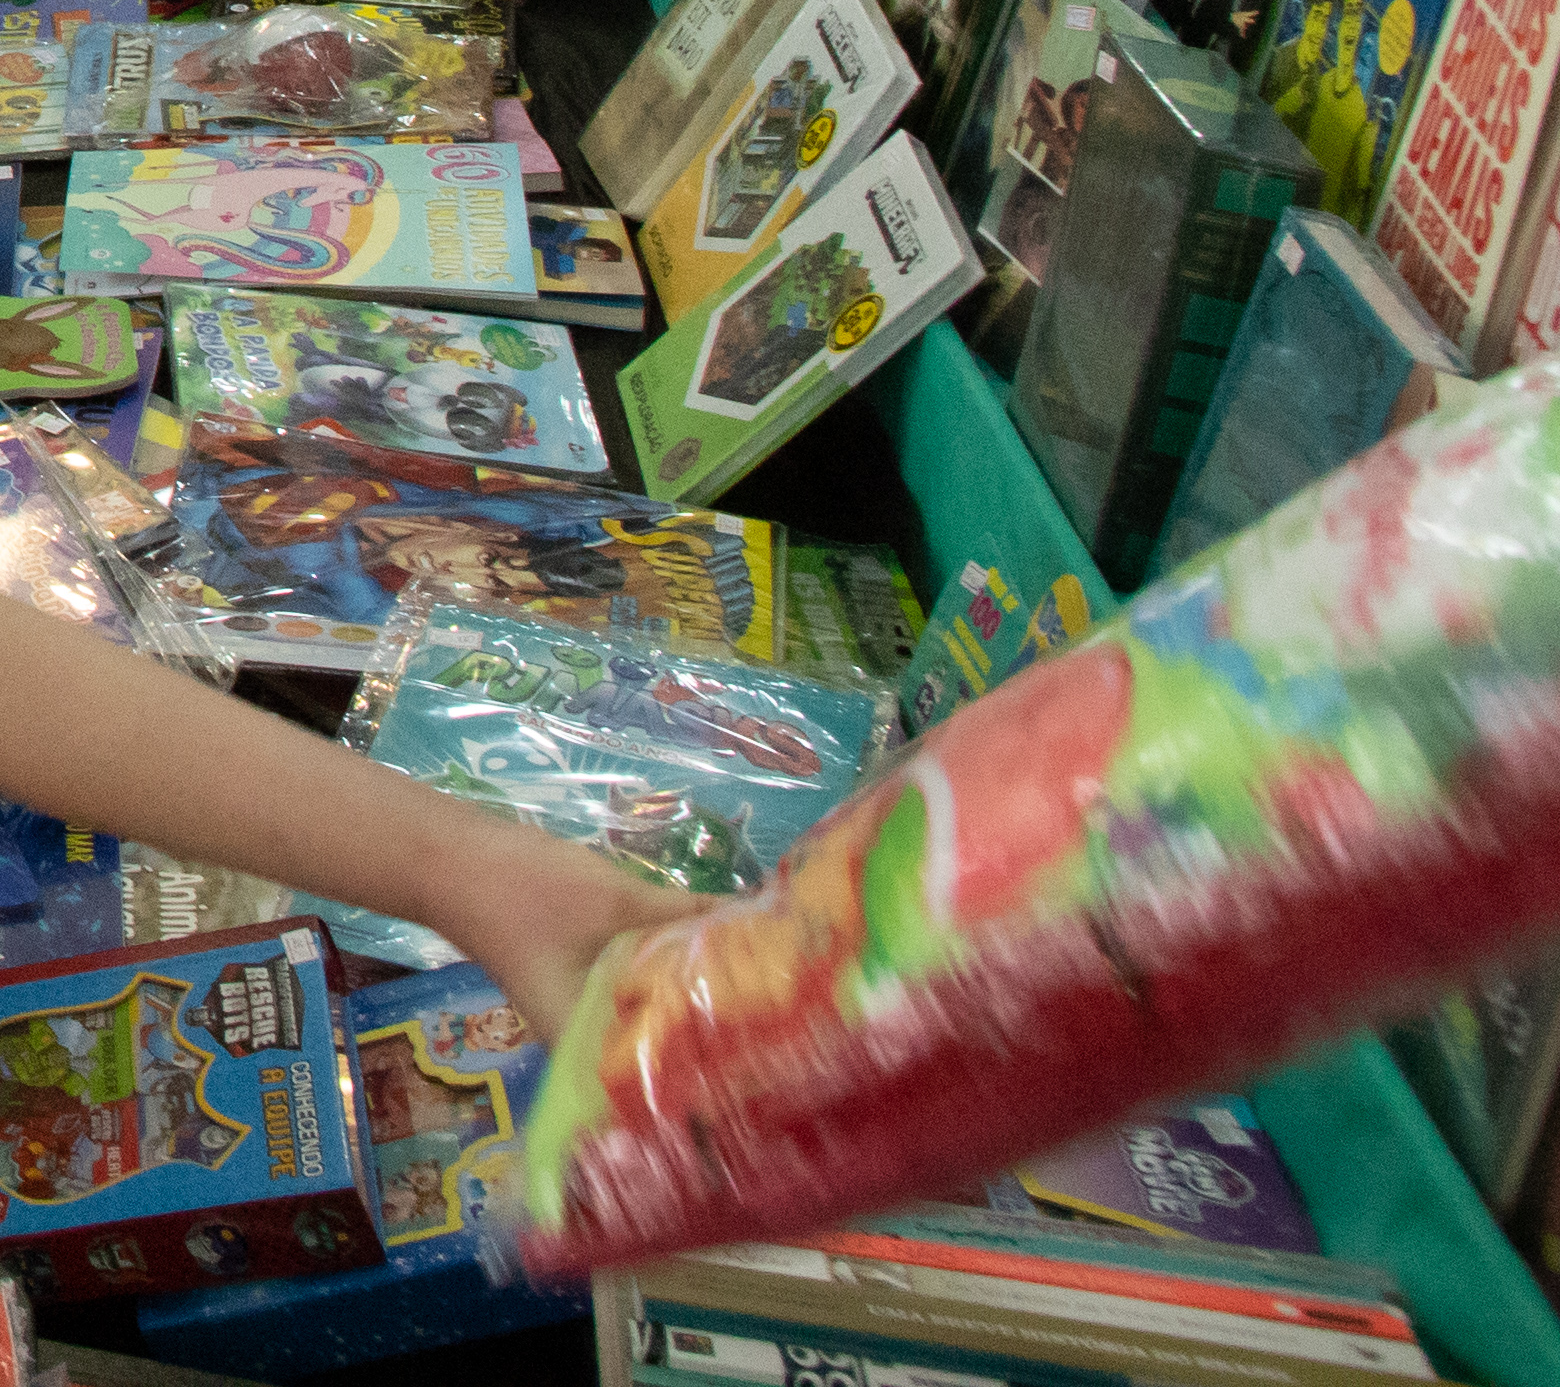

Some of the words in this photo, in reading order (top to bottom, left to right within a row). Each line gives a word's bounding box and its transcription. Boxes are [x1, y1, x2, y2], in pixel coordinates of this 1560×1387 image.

[1406, 82, 1505, 256] DEMAIS
[219, 981, 250, 1046] BOTS
[244, 965, 277, 1049] RESCUE
[259, 1067, 287, 1085] A
[290, 1060, 324, 1179] CONHECENDO
[261, 1088, 299, 1182] EQUIPE
